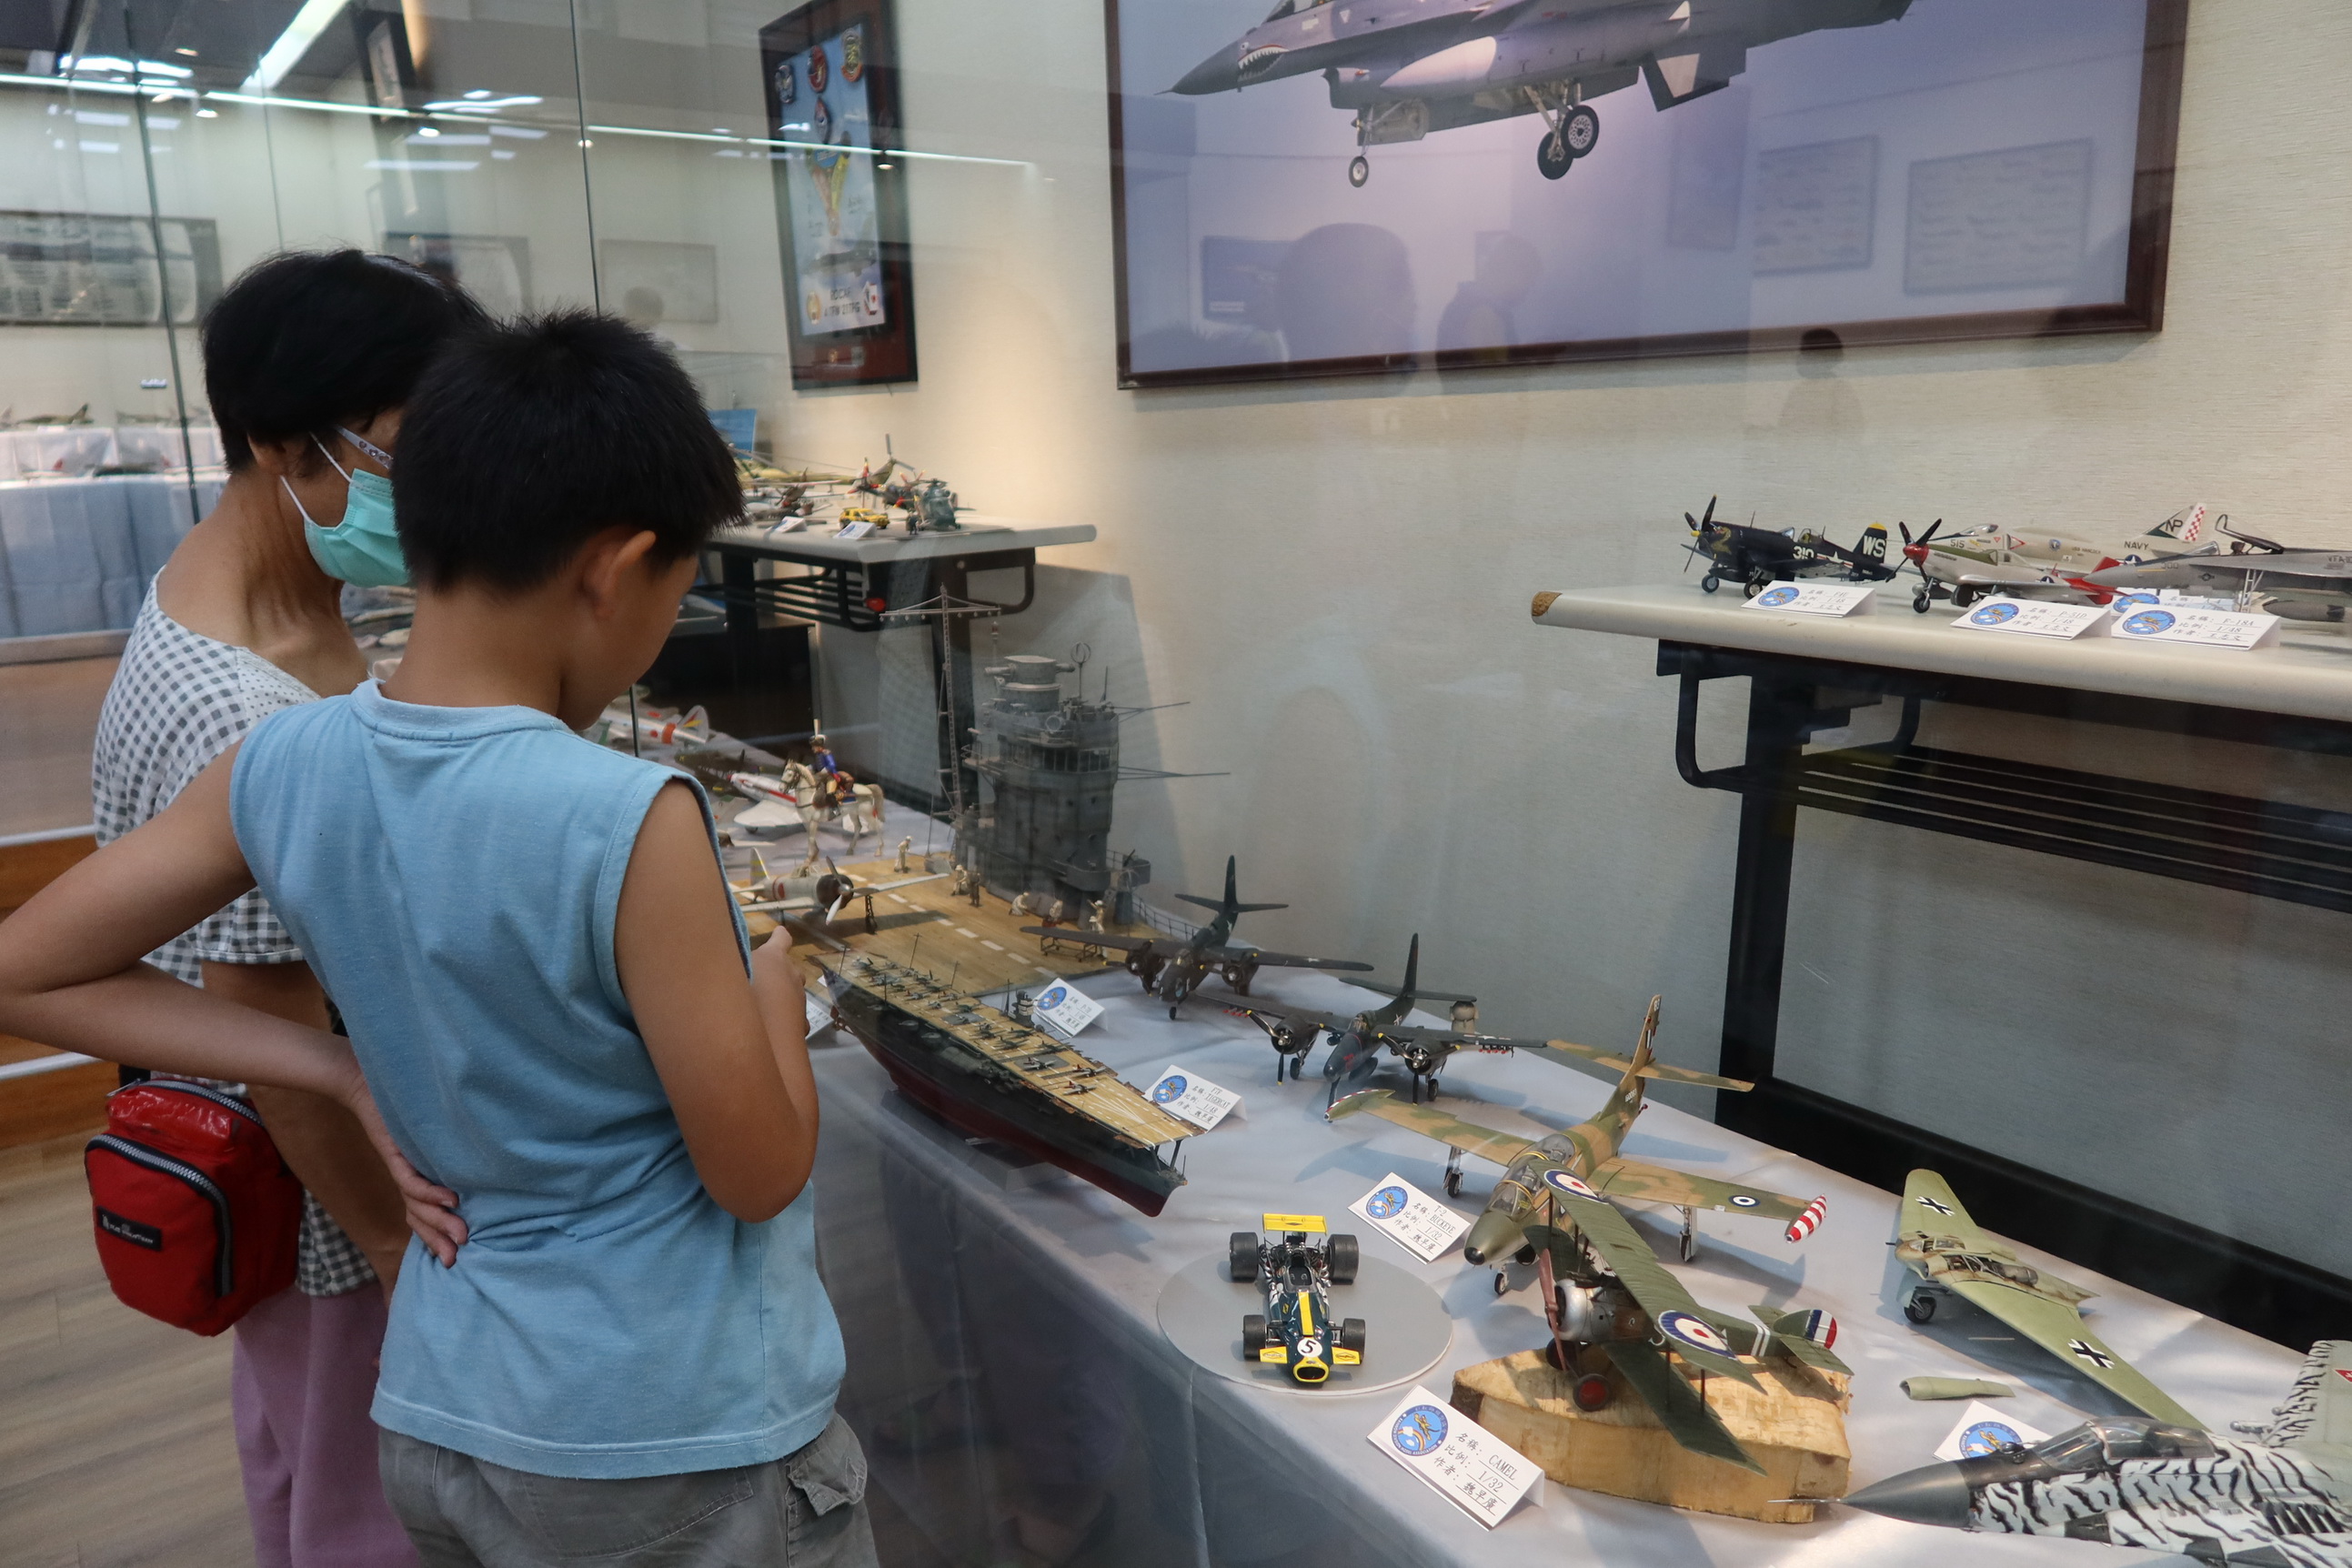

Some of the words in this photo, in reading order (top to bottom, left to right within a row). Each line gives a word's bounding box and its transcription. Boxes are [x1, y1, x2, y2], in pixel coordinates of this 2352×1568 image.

[2165, 519, 2183, 532] NP
[1863, 535, 1886, 558] WS
[1950, 539, 1965, 548] 515
[2124, 540, 2149, 550] NAVY
[1792, 545, 1815, 560] 310
[1433, 1204, 1448, 1217] T-2
[1429, 1213, 1456, 1234] BUCKEYE
[1424, 1226, 1443, 1241] 1/32
[1301, 1340, 1316, 1353] 5
[1488, 1454, 1518, 1481] CAMEL
[1477, 1470, 1504, 1493] 1/32
